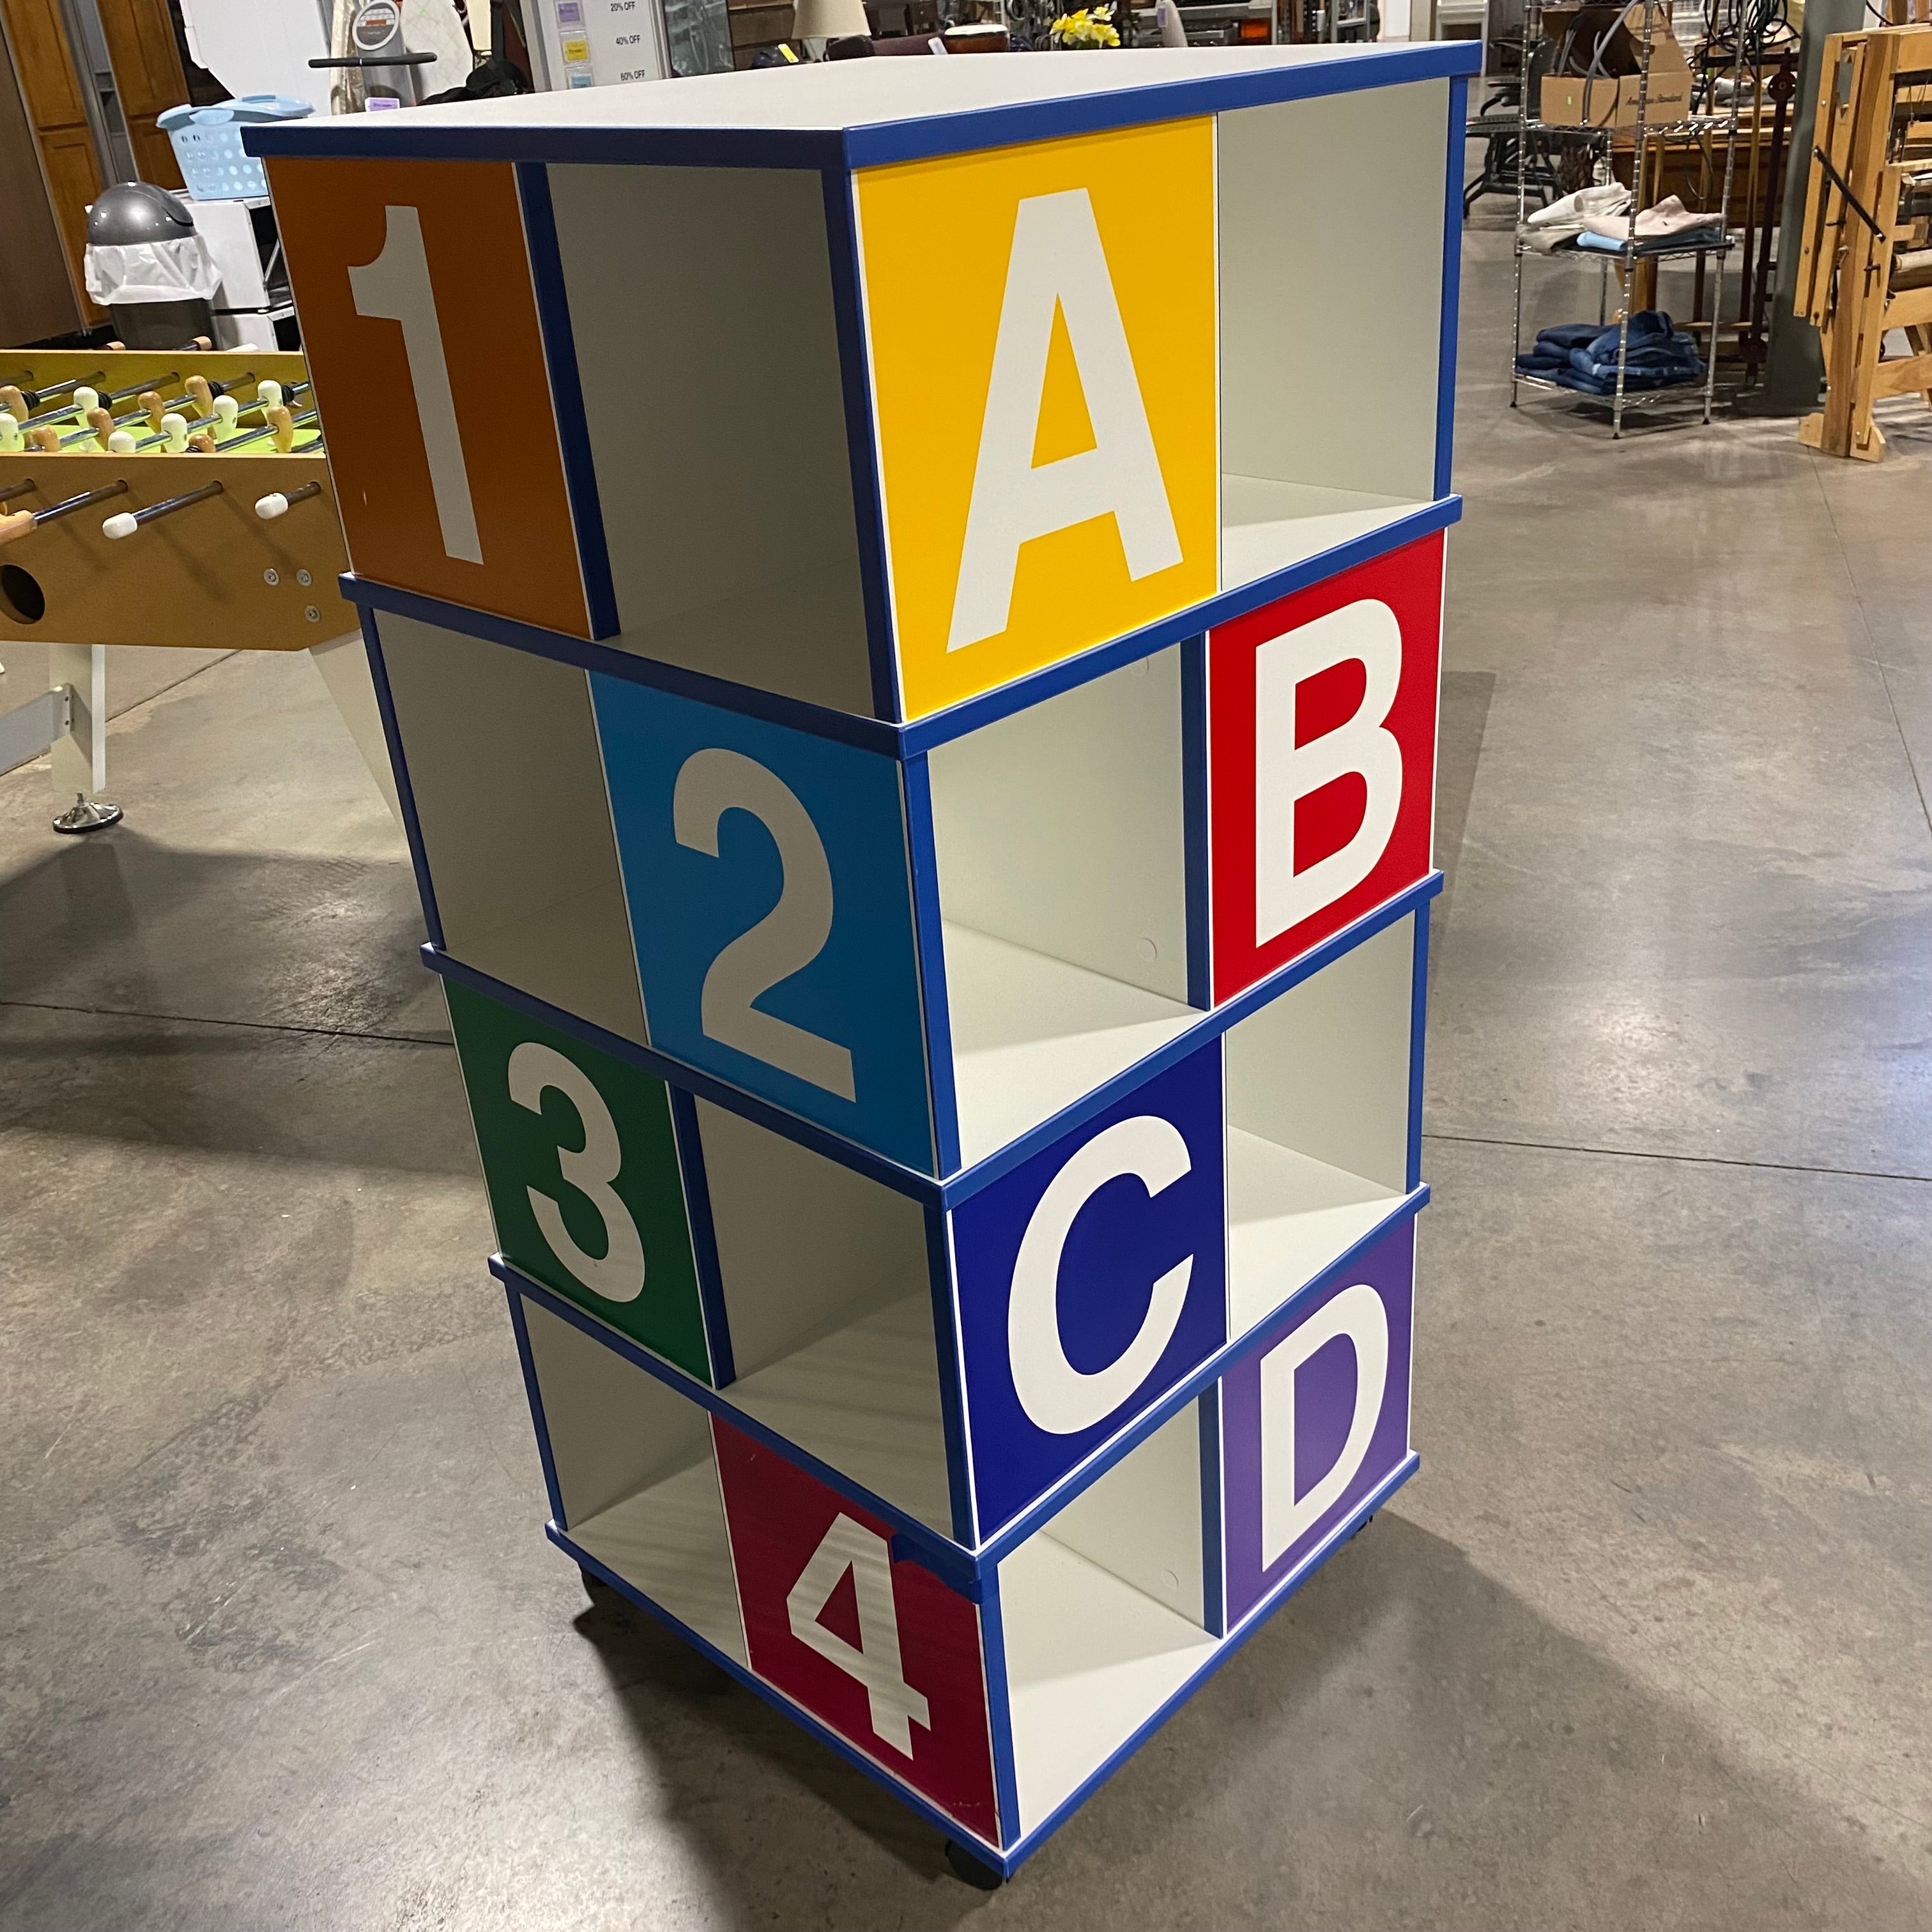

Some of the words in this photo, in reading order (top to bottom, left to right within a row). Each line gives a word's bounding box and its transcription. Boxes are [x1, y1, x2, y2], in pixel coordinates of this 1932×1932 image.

[610, 3, 623, 12] 20%
[624, 1, 635, 10] OFF
[615, 36, 628, 45] 40%
[629, 34, 640, 43] OFF
[620, 72, 633, 81] 60%
[634, 70, 645, 79] OFF
[348, 206, 484, 565] 1
[947, 189, 1183, 652] A
[1255, 599, 1403, 948] B
[673, 748, 856, 1103] 2
[509, 1042, 645, 1303] 3
[1008, 1116, 1194, 1435] C
[1260, 1284, 1390, 1573] D
[786, 1512, 931, 1761] 4
